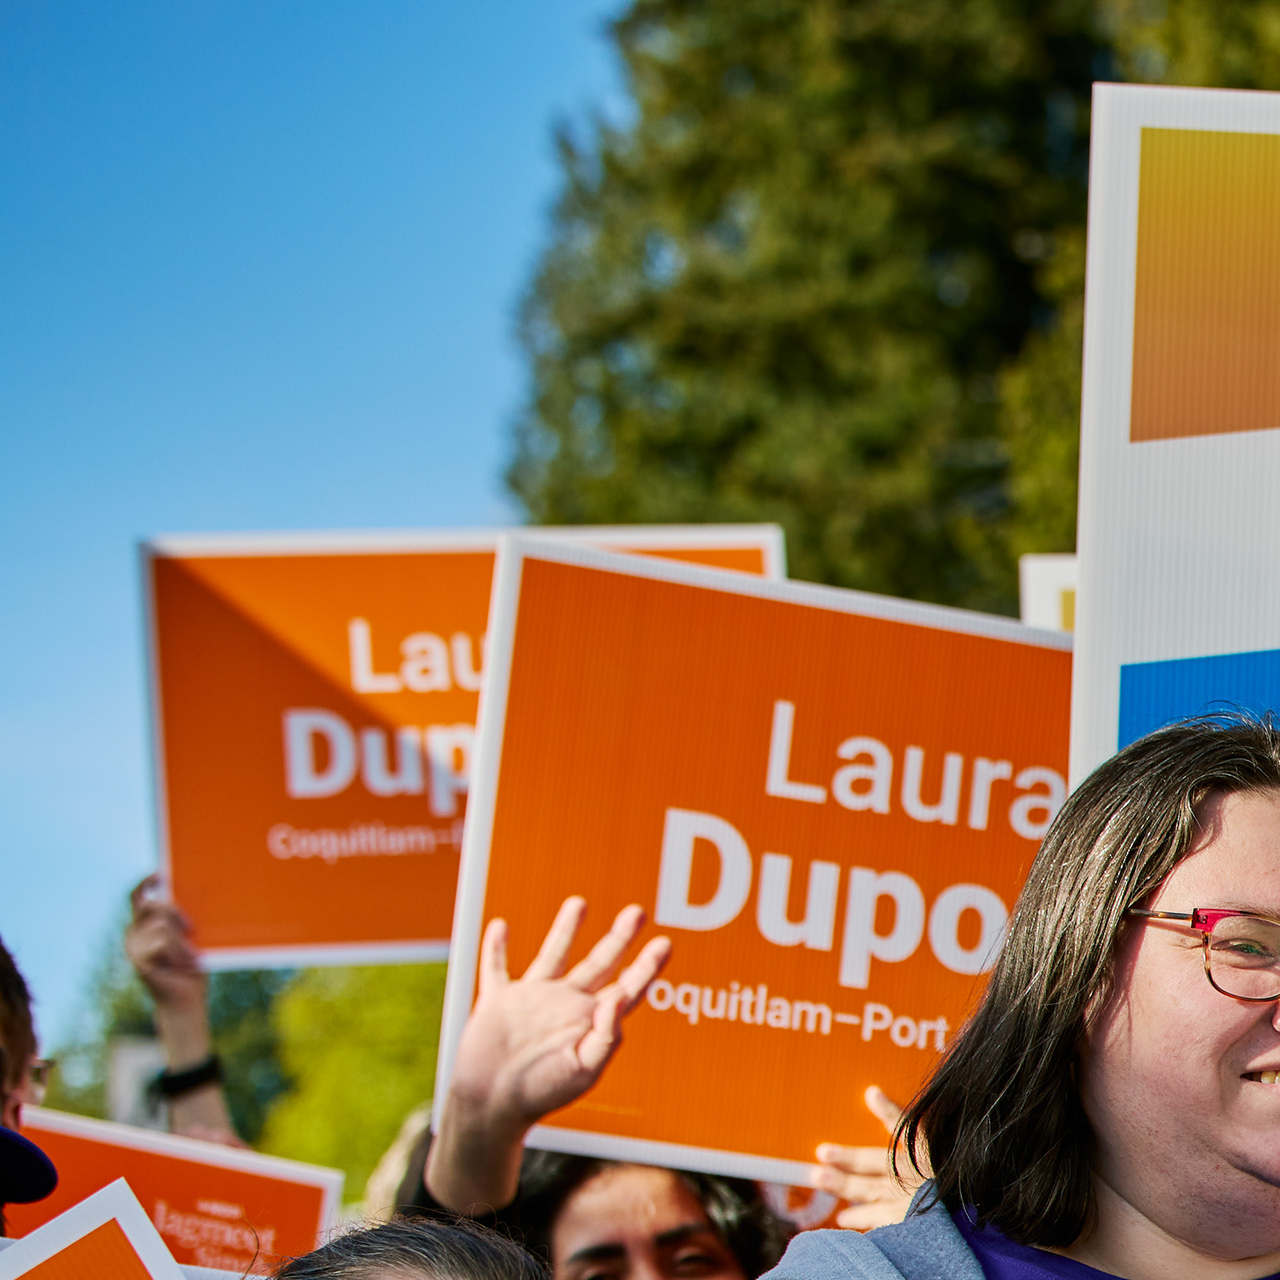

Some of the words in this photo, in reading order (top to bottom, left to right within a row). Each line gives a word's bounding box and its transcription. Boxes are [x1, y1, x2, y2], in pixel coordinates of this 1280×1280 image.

[348, 617, 486, 693] Lau
[766, 700, 1068, 841] Laura
[655, 808, 1010, 990] Dupo
[646, 979, 949, 1053] oquitlam–Port
